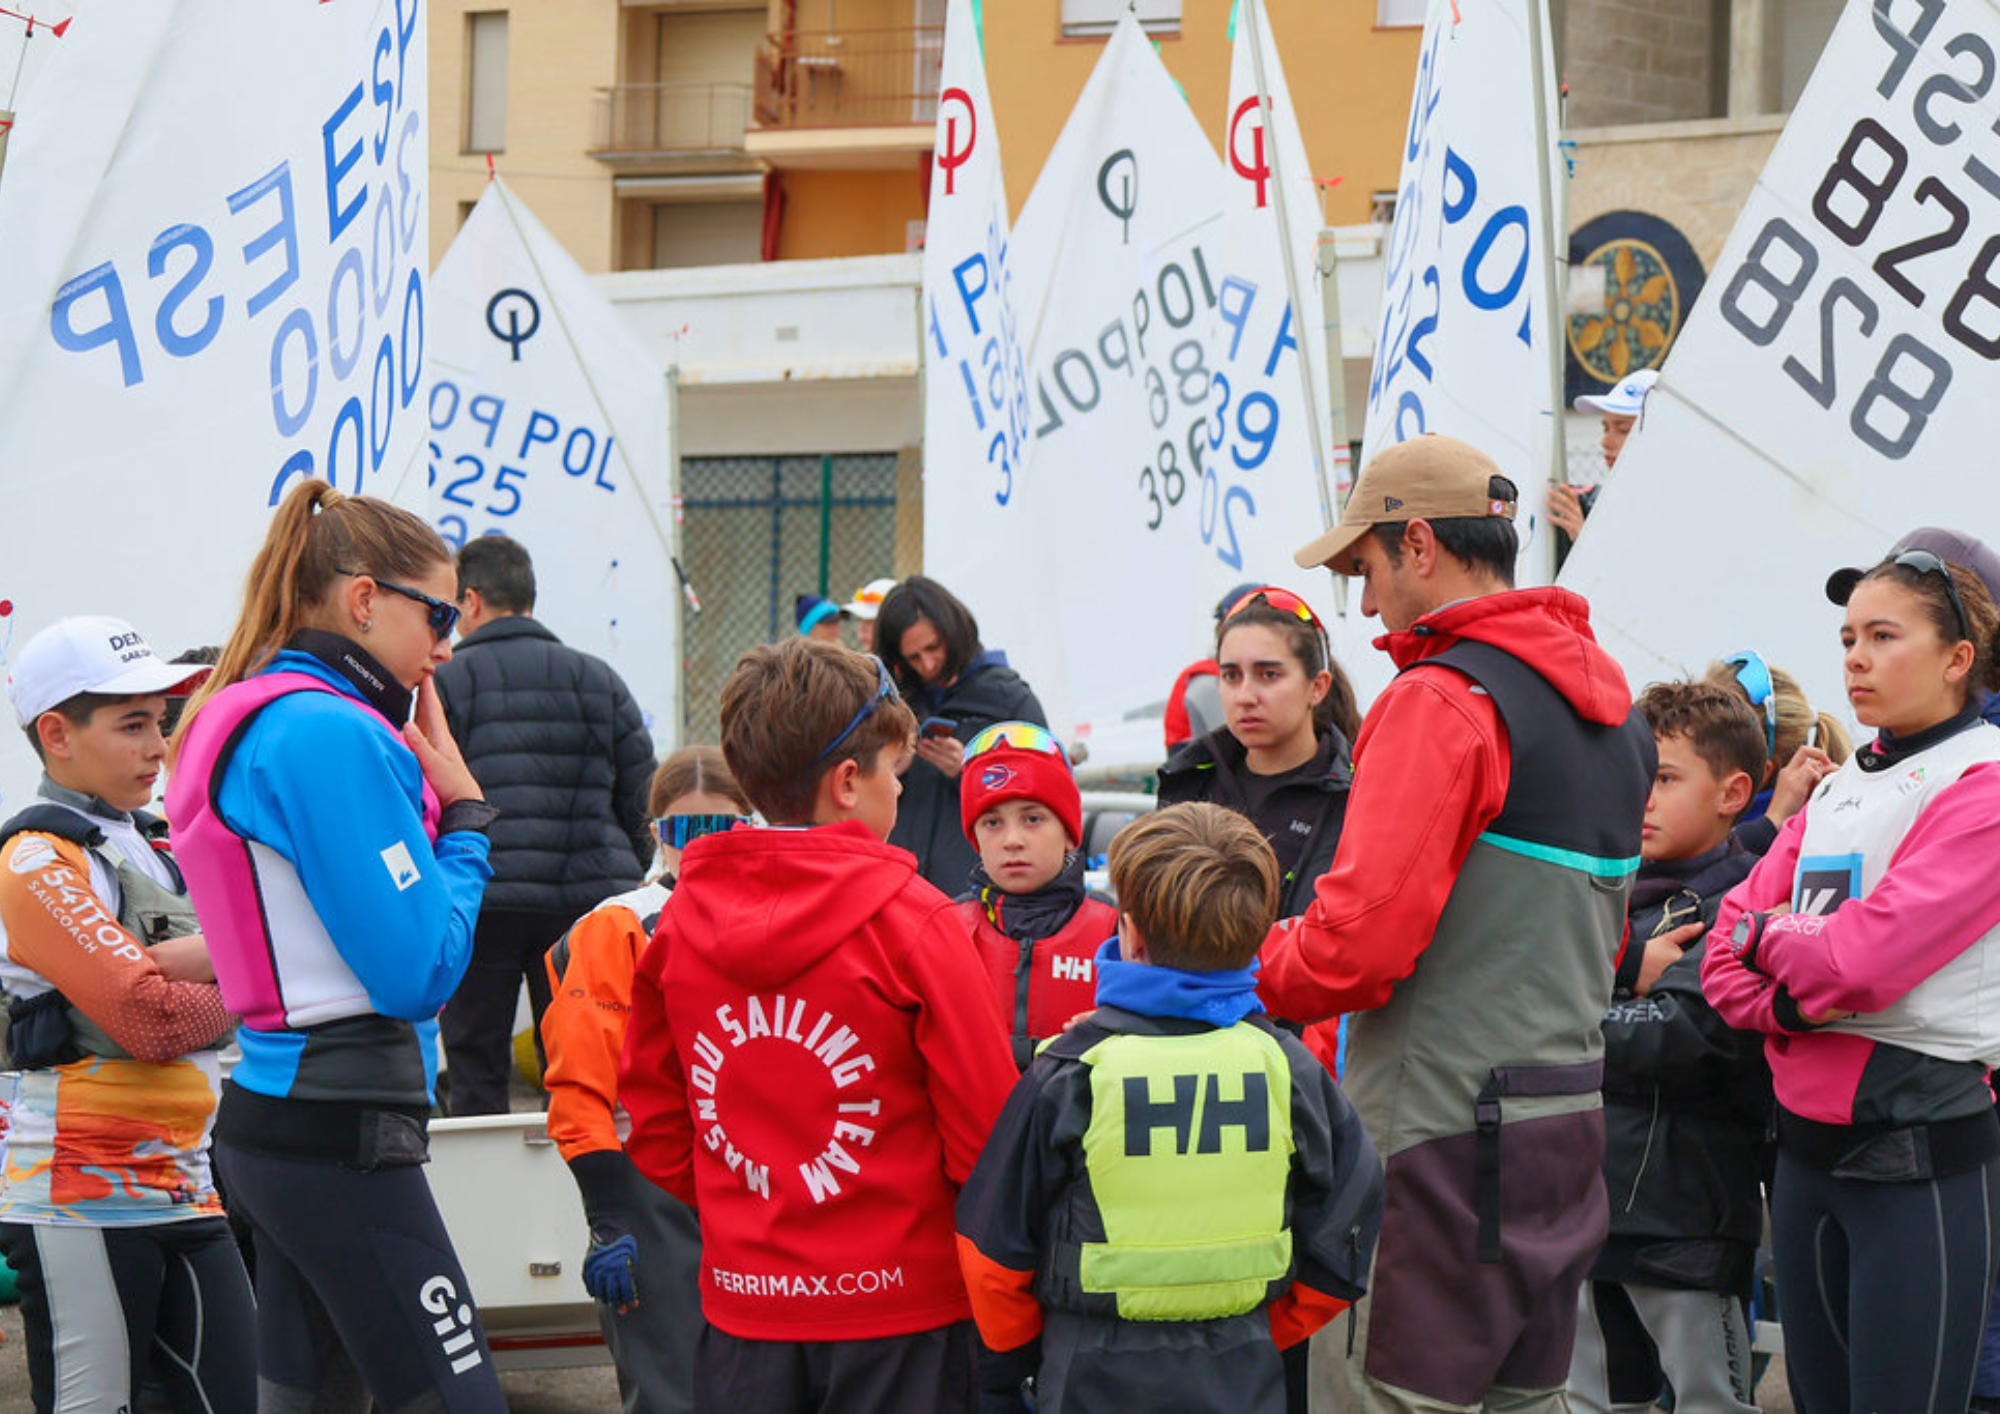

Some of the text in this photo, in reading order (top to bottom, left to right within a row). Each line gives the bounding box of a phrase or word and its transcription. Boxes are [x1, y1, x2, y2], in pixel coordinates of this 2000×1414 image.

[518, 409, 617, 493] POL
[27, 879, 99, 955] SAILCOACH
[1051, 954, 1093, 983] HH
[690, 993, 882, 1205] MASNOU SAILING TEAM
[1122, 1072, 1271, 1157] HH
[712, 1266, 905, 1298] FERRIMAX.COM
[420, 1275, 483, 1376] Gill
